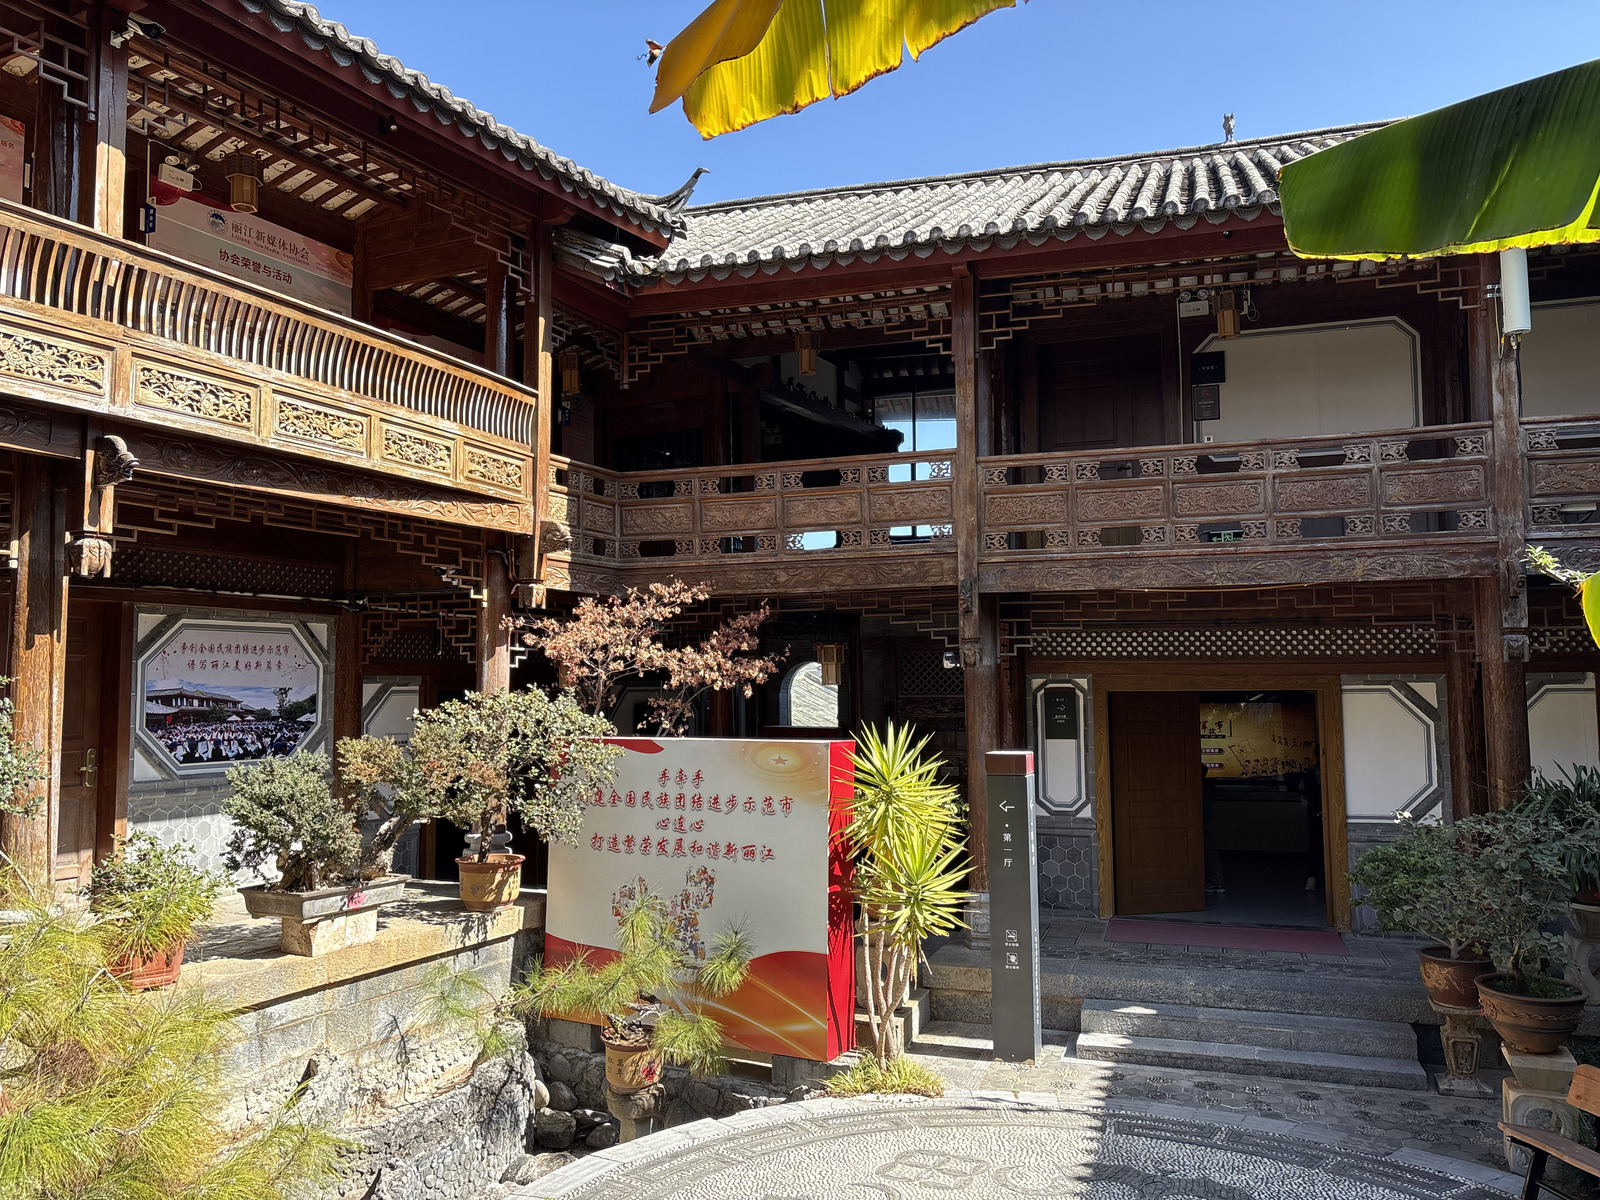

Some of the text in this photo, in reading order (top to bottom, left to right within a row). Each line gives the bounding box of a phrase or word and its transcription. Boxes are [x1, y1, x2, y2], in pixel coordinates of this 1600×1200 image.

[231, 221, 310, 260] 丽江新媒体协会
[218, 248, 293, 285] 协会荣誉与活动
[658, 767, 704, 788] 手牵手
[656, 815, 705, 833] 心连心
[590, 832, 776, 862] 打造繁荣发展和谐新丽江
[1002, 832, 1013, 868] 第一厅
